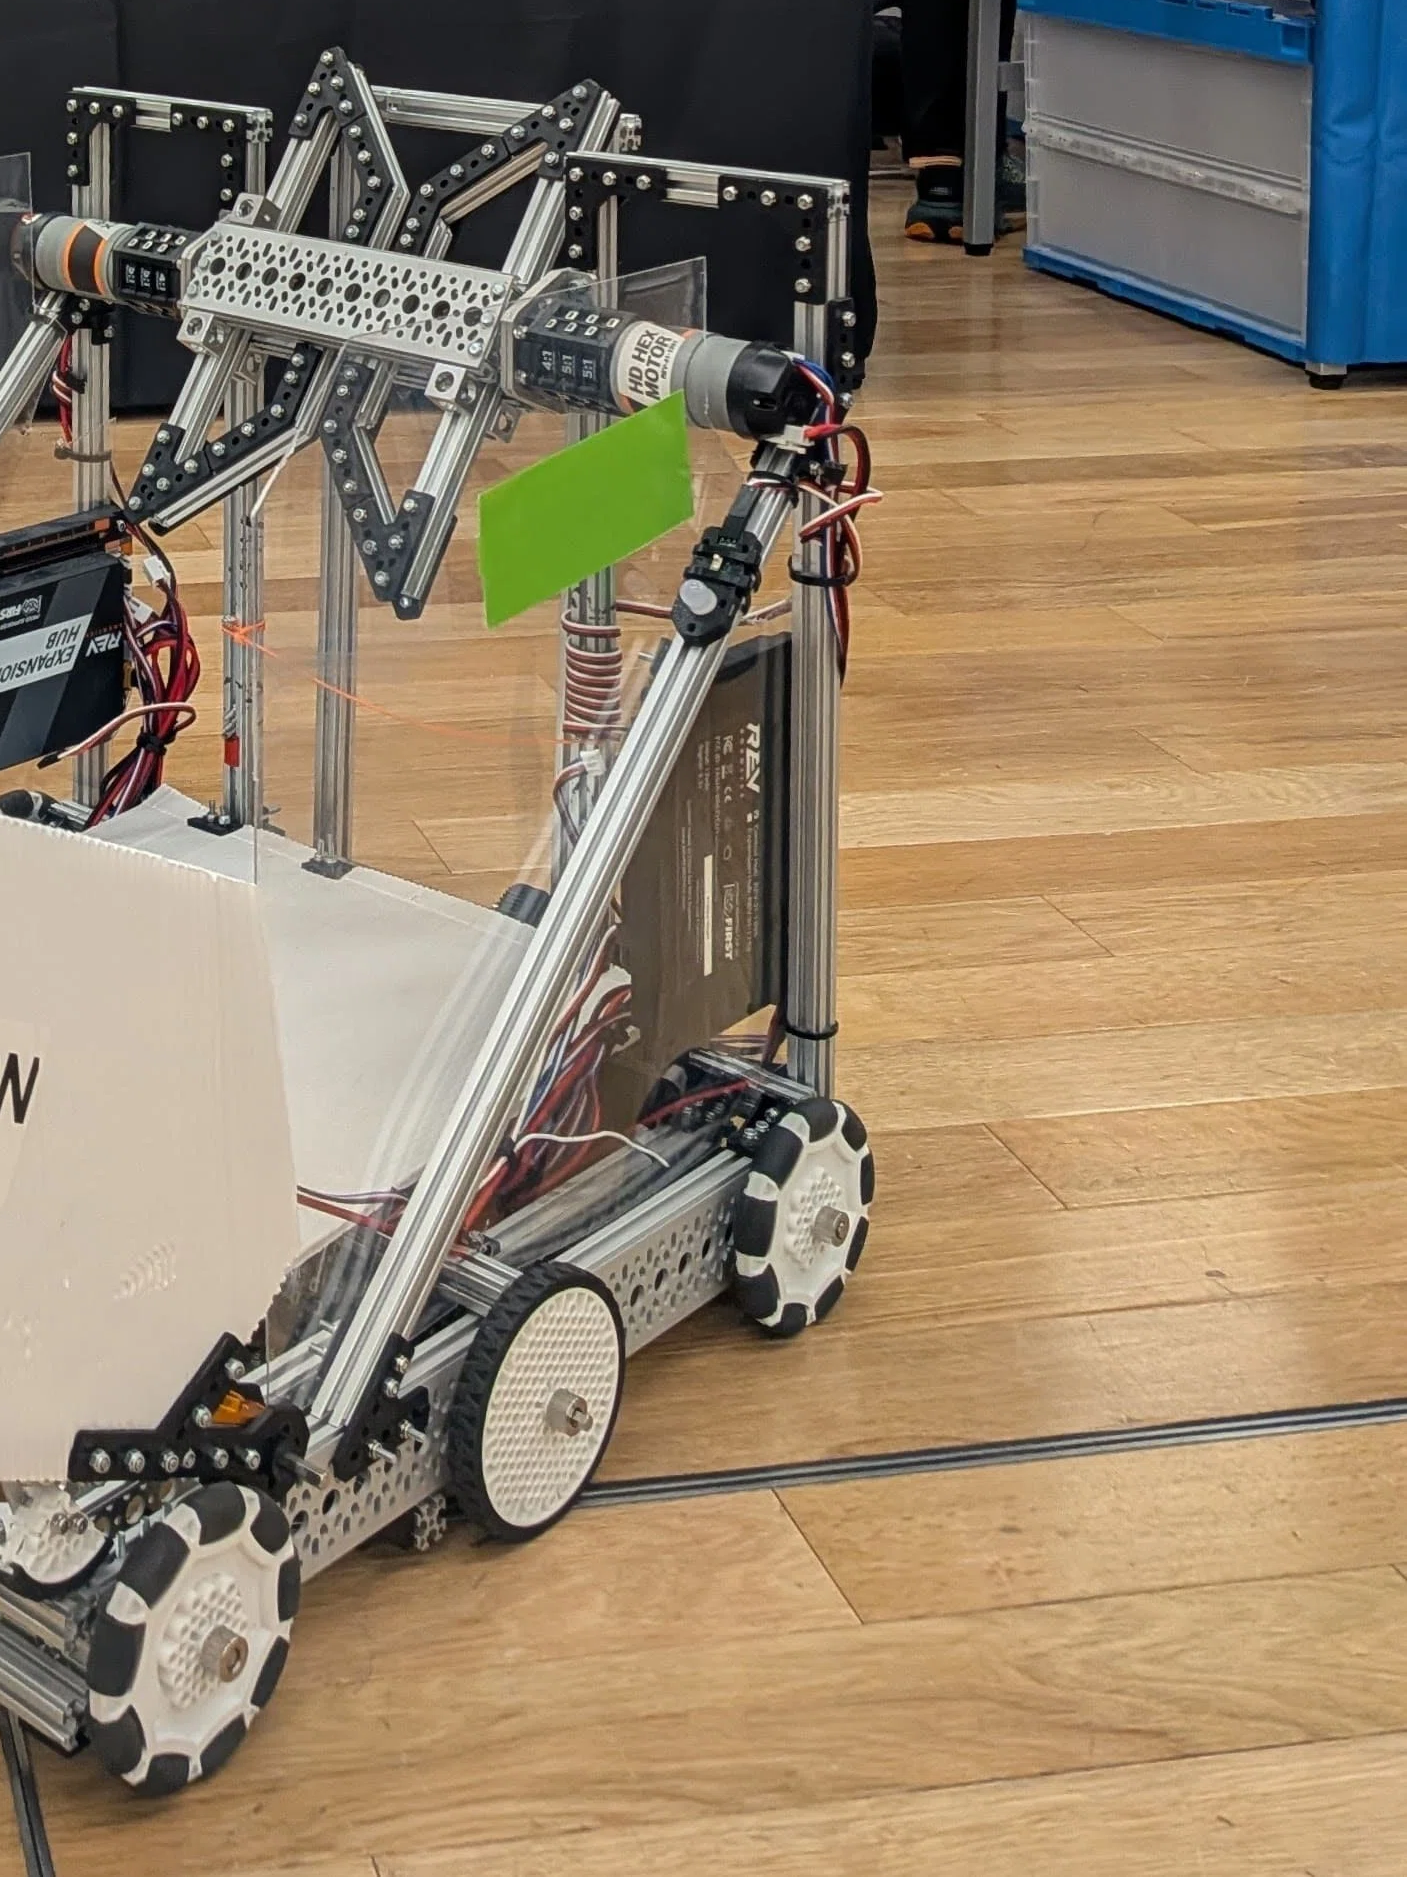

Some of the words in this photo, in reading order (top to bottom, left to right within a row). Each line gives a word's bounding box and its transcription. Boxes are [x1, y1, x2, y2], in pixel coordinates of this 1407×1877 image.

[632, 329, 659, 363] HEX
[628, 366, 645, 395] HD
[644, 335, 672, 400] MOTOR
[45, 623, 82, 650] HUB
[85, 630, 123, 657] REV
[746, 723, 760, 793] REV
[724, 917, 733, 960] FIRST
